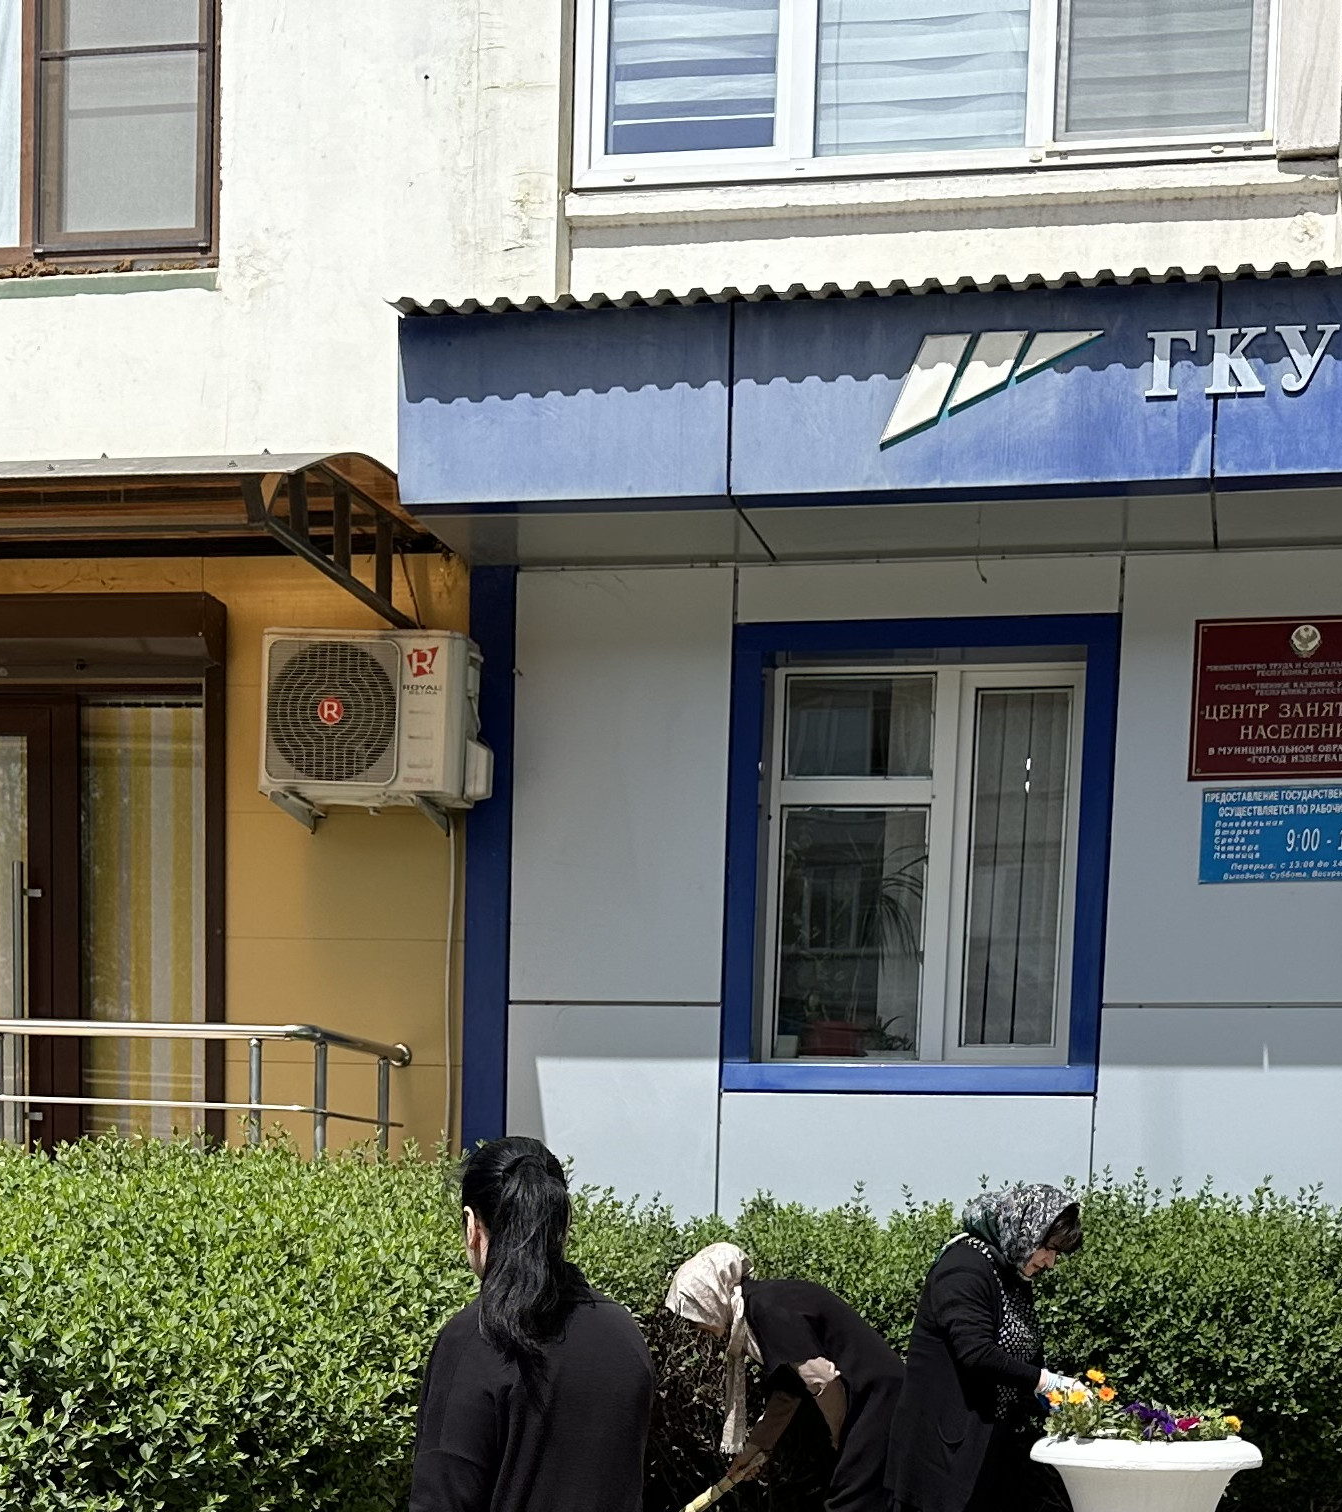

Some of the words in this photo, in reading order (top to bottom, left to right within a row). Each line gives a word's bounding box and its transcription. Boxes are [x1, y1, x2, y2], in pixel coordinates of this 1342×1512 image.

[1145, 323, 1340, 400] ГКУ
[412, 650, 432, 674] R
[324, 702, 339, 719] R
[1208, 747, 1215, 756] В
[1217, 744, 1314, 756] МУНИЦИПАЛЬНОМ
[1205, 790, 1279, 804] ПРЕДОСТАВЛЕНИЕ
[1218, 805, 1295, 818] ОСУЩЕСТВЛЯЕТСЯ
[1297, 804, 1308, 815] ПО
[1214, 835, 1245, 844] Среда
[1286, 828, 1320, 852] 9:00
